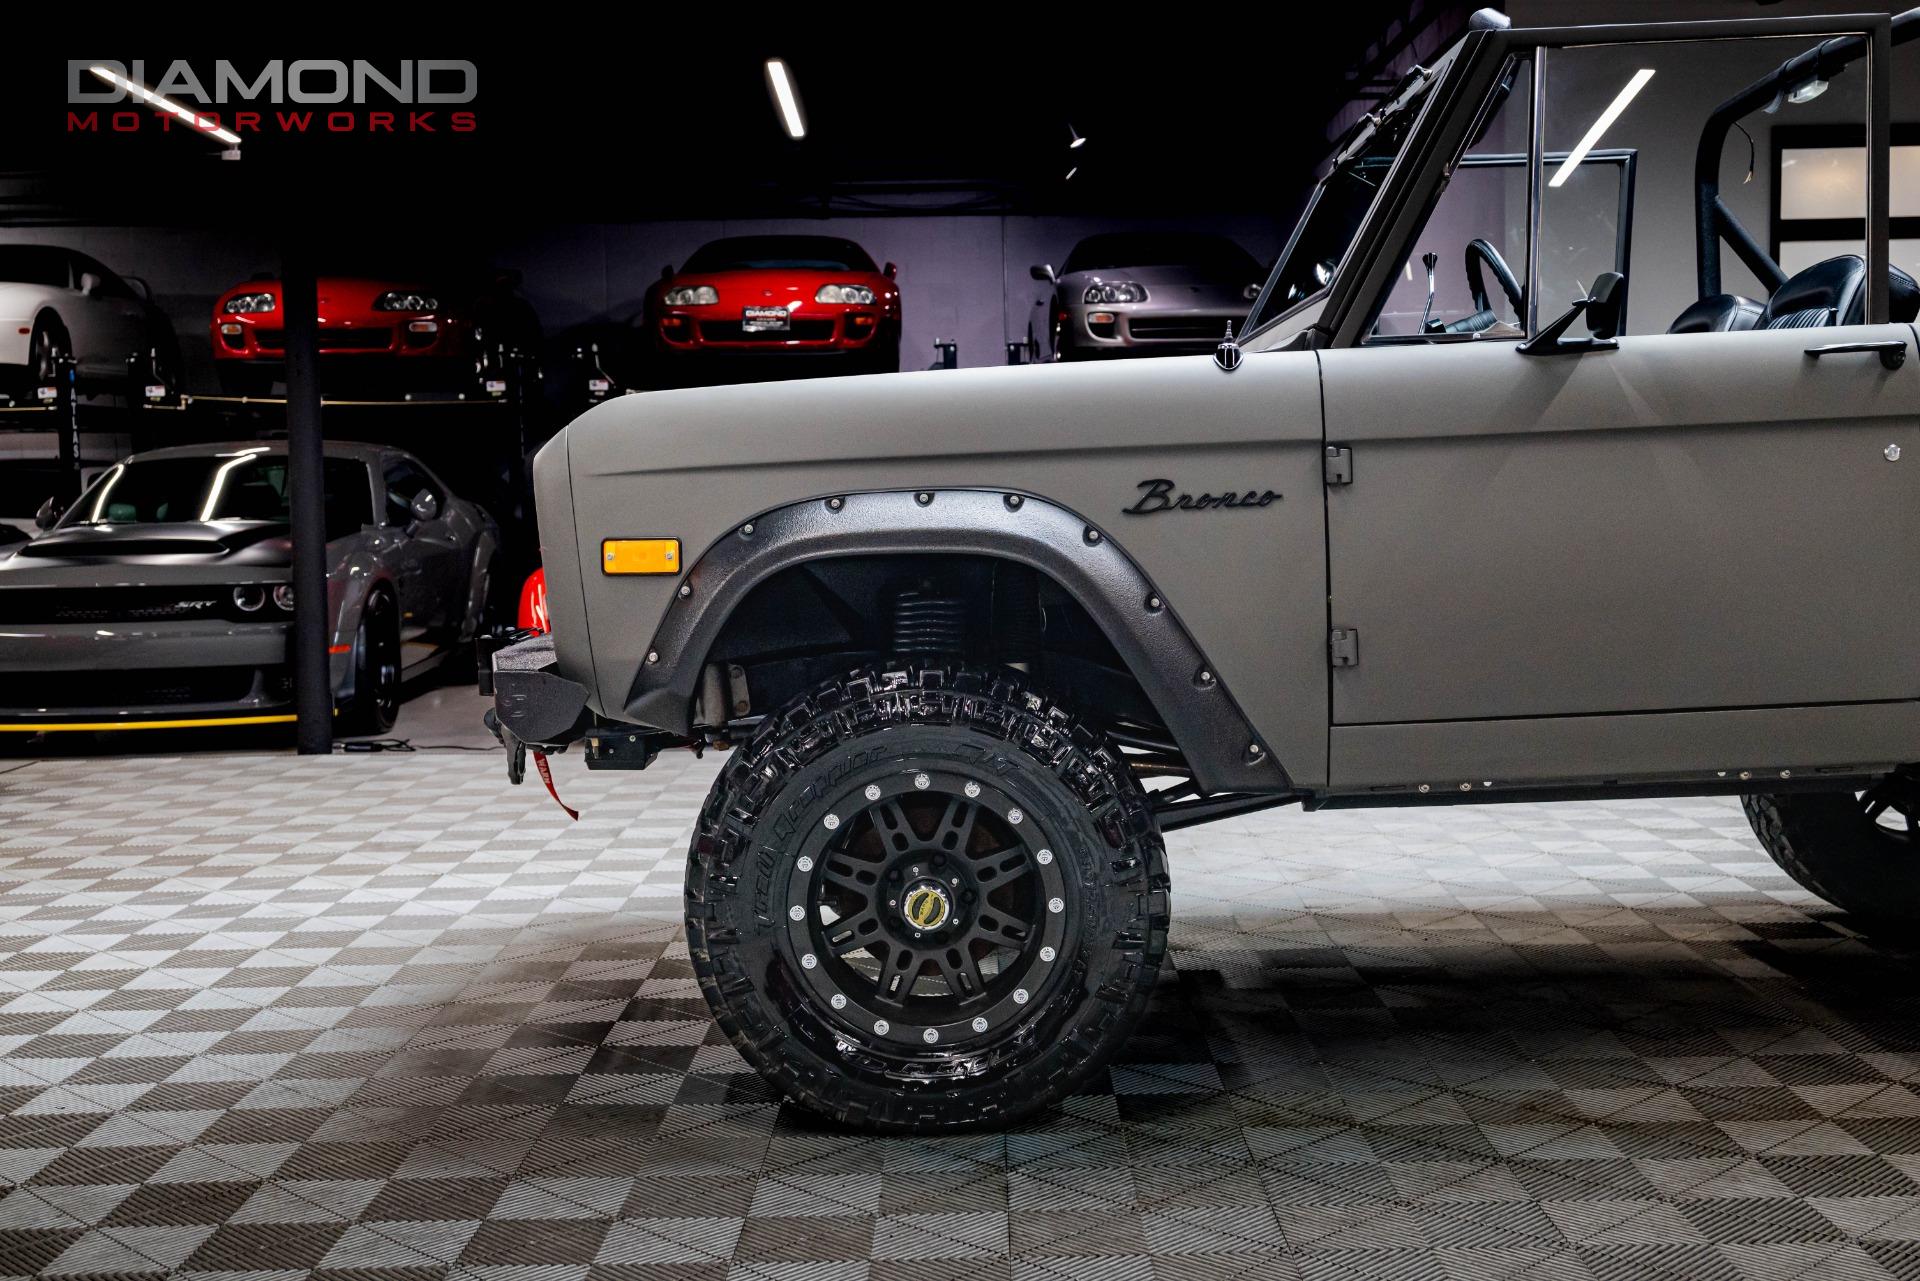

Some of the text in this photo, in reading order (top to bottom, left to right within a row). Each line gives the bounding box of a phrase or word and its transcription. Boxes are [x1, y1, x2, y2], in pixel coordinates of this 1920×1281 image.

[71, 387, 79, 459] ATLAS
[1122, 478, 1283, 514] Bronco
[538, 757, 551, 785] WARN
